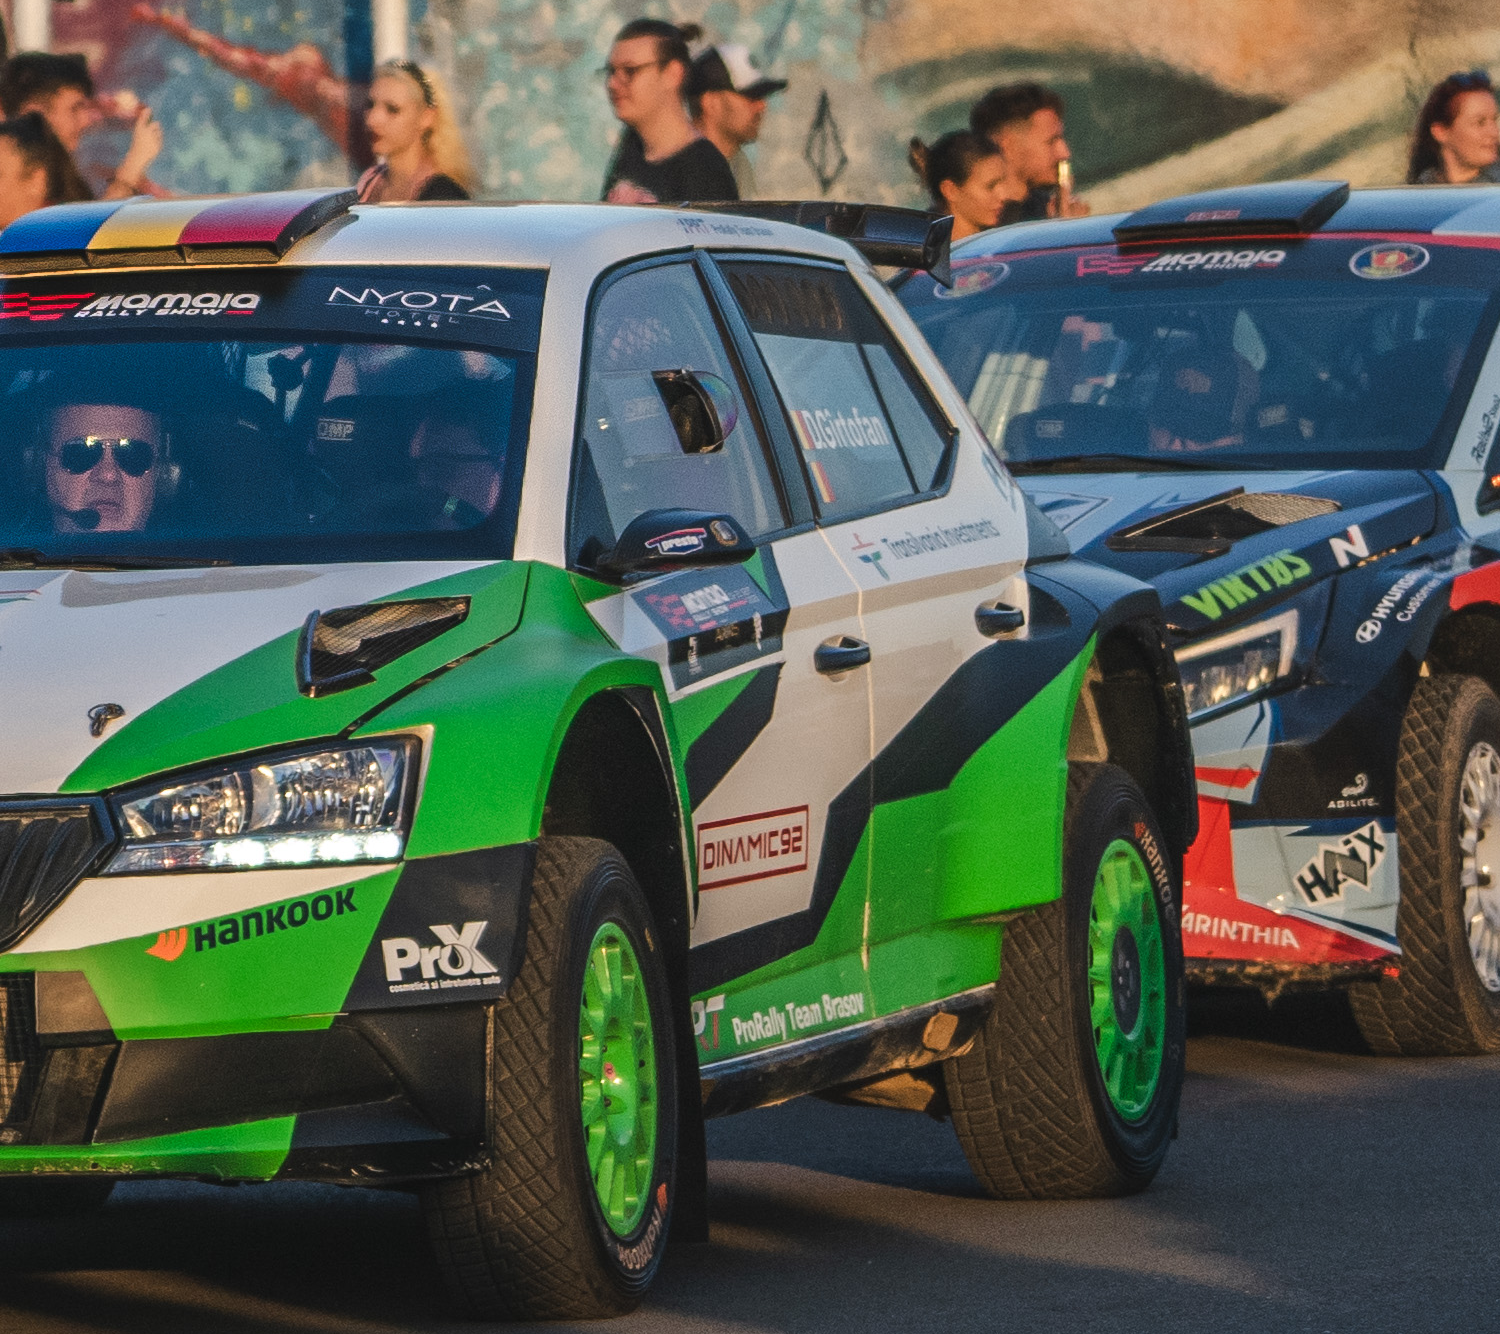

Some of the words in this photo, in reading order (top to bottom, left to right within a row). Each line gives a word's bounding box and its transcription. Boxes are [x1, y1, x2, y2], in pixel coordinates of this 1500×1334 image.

[74, 309, 143, 318] RALLY
[155, 307, 222, 317] SHOW
[82, 292, 261, 311] Mamaia
[702, 824, 803, 871] DINAMIC92
[1181, 905, 1300, 949] ARINTHIA
[731, 1004, 788, 1046] ProRally
[785, 999, 821, 1031] Team
[820, 992, 866, 1020] Brasov
